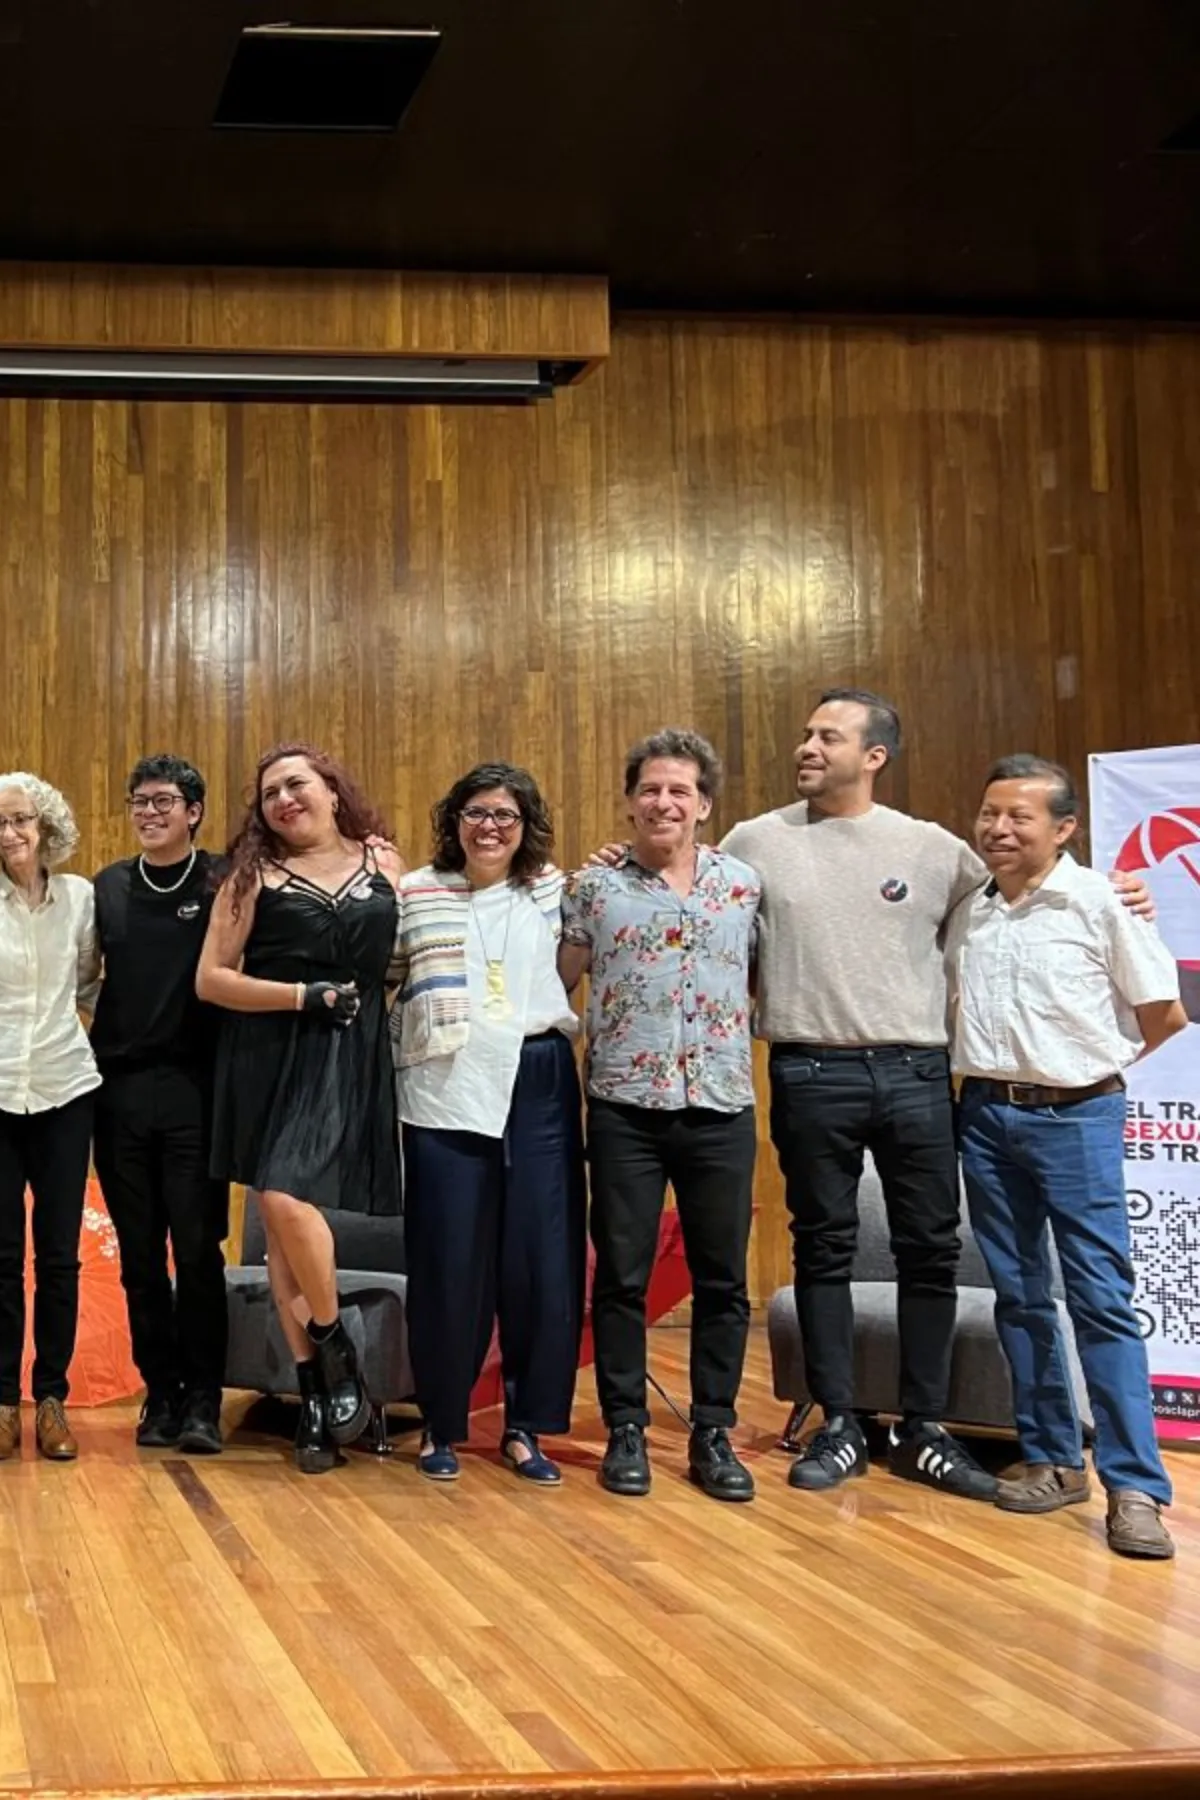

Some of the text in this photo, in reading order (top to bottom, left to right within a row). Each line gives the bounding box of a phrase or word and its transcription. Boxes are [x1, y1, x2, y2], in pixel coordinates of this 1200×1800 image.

[1125, 1101, 1200, 1120] EL TR
[1124, 1121, 1200, 1141] SEXU
[1124, 1142, 1155, 1161] ES
